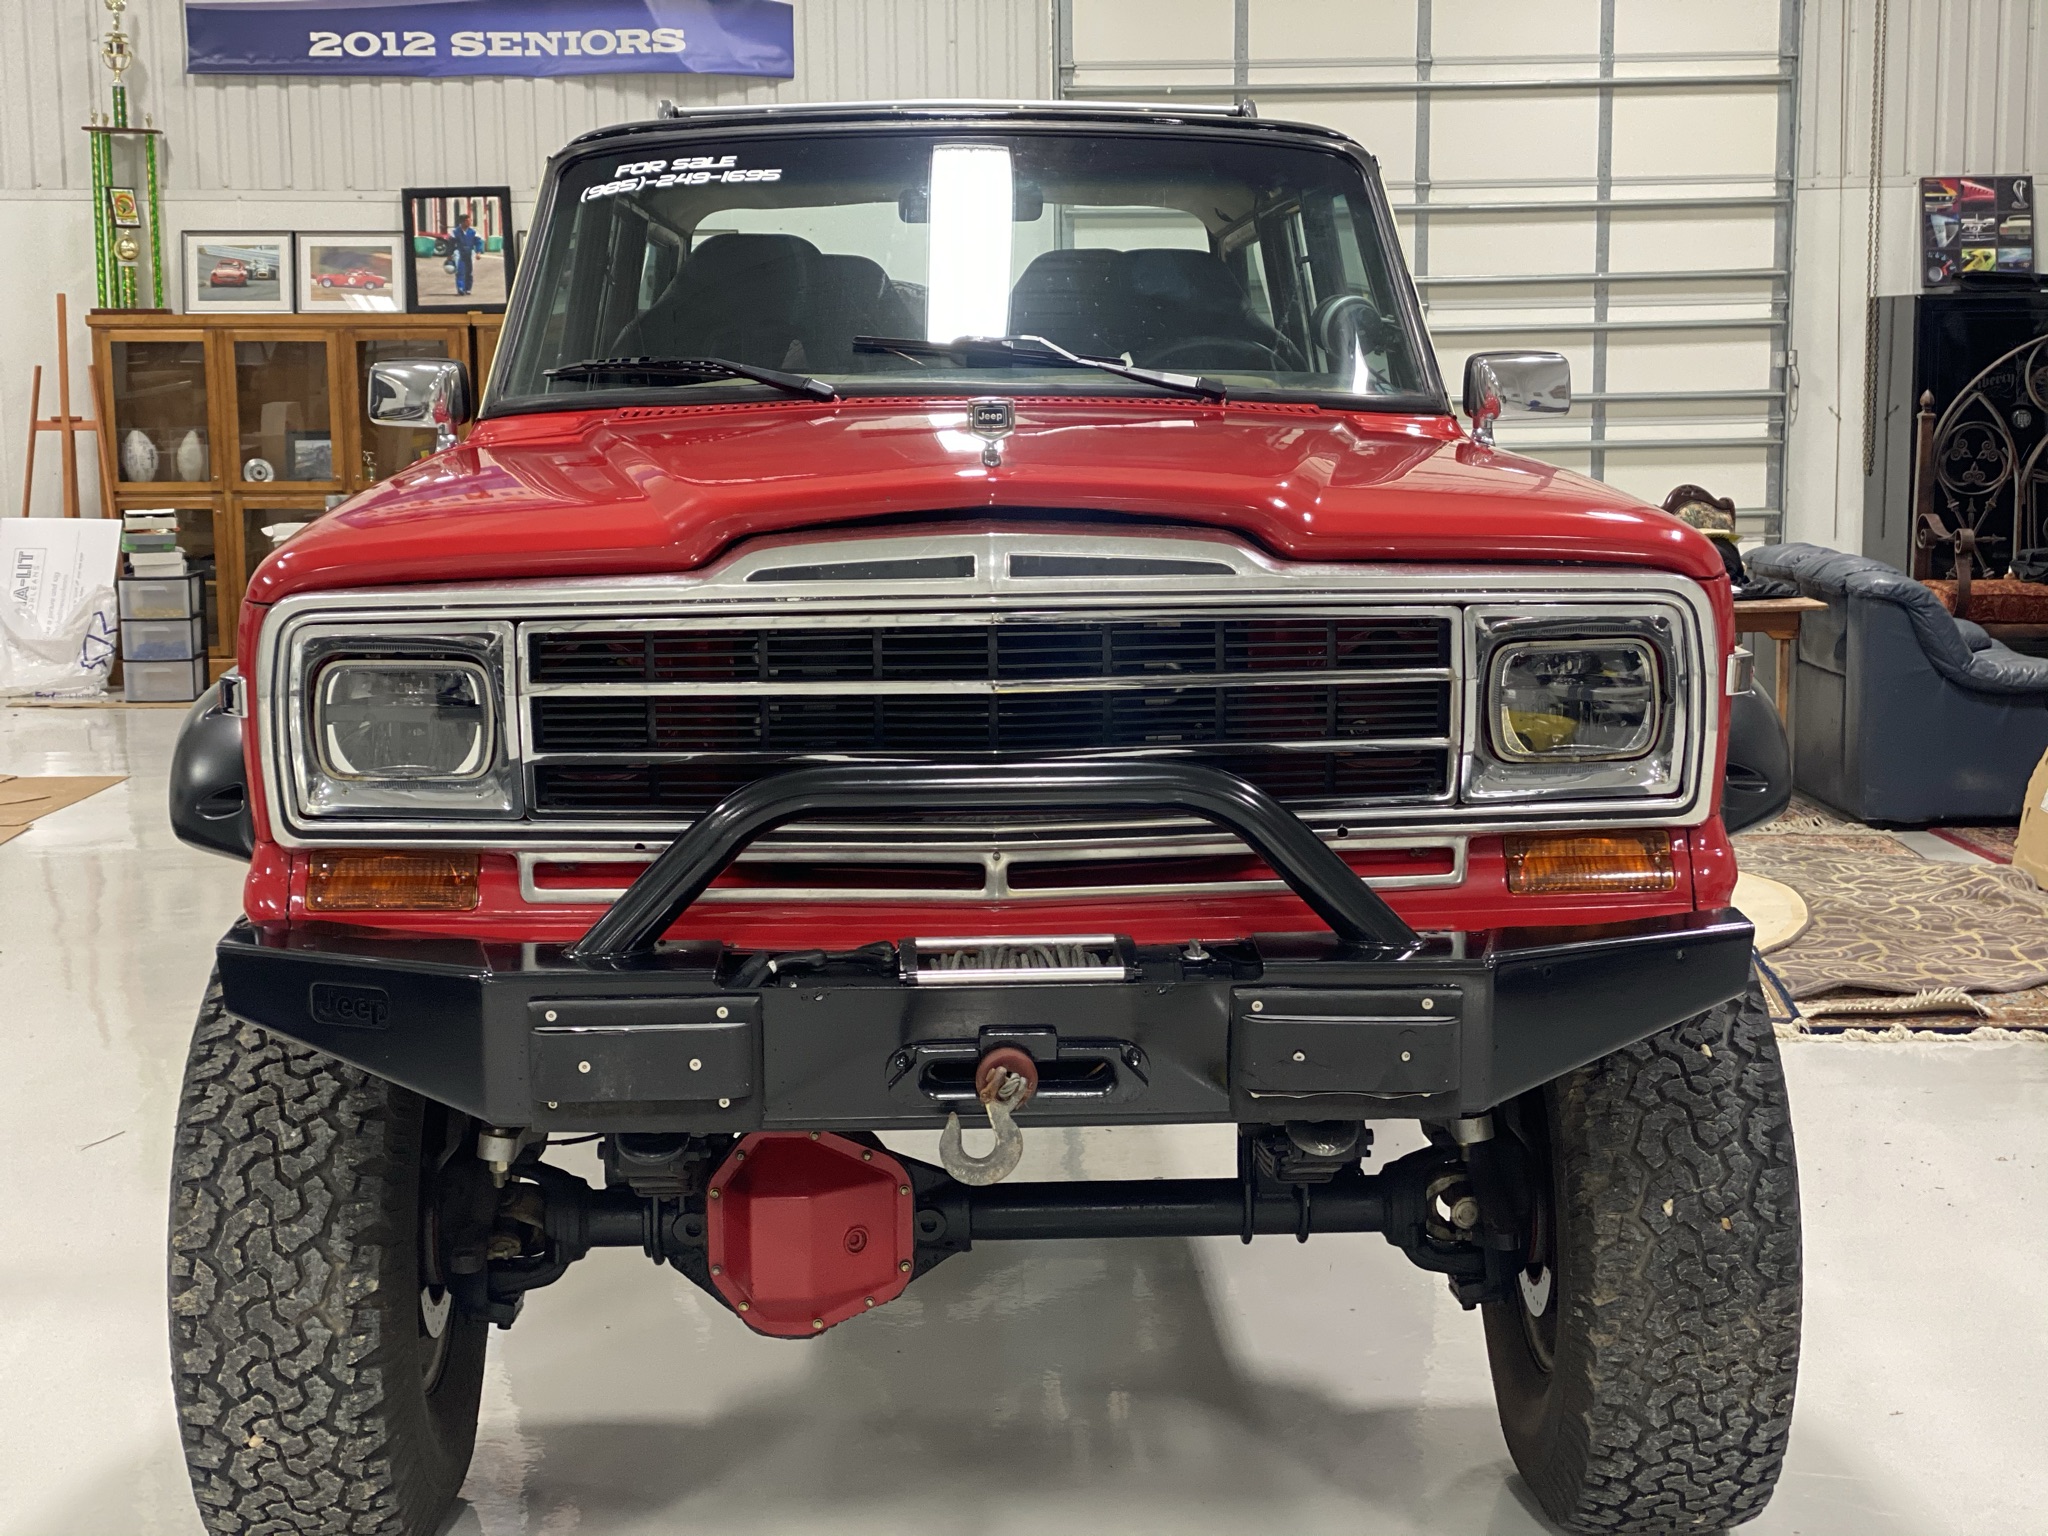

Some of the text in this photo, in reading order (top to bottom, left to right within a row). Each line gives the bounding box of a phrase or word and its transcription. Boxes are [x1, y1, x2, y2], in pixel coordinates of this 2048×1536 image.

[308, 28, 687, 57] 2012 SENIORS
[614, 160, 668, 178] FOR
[979, 412, 1003, 422] Jeep
[317, 988, 389, 1026] Jeep
